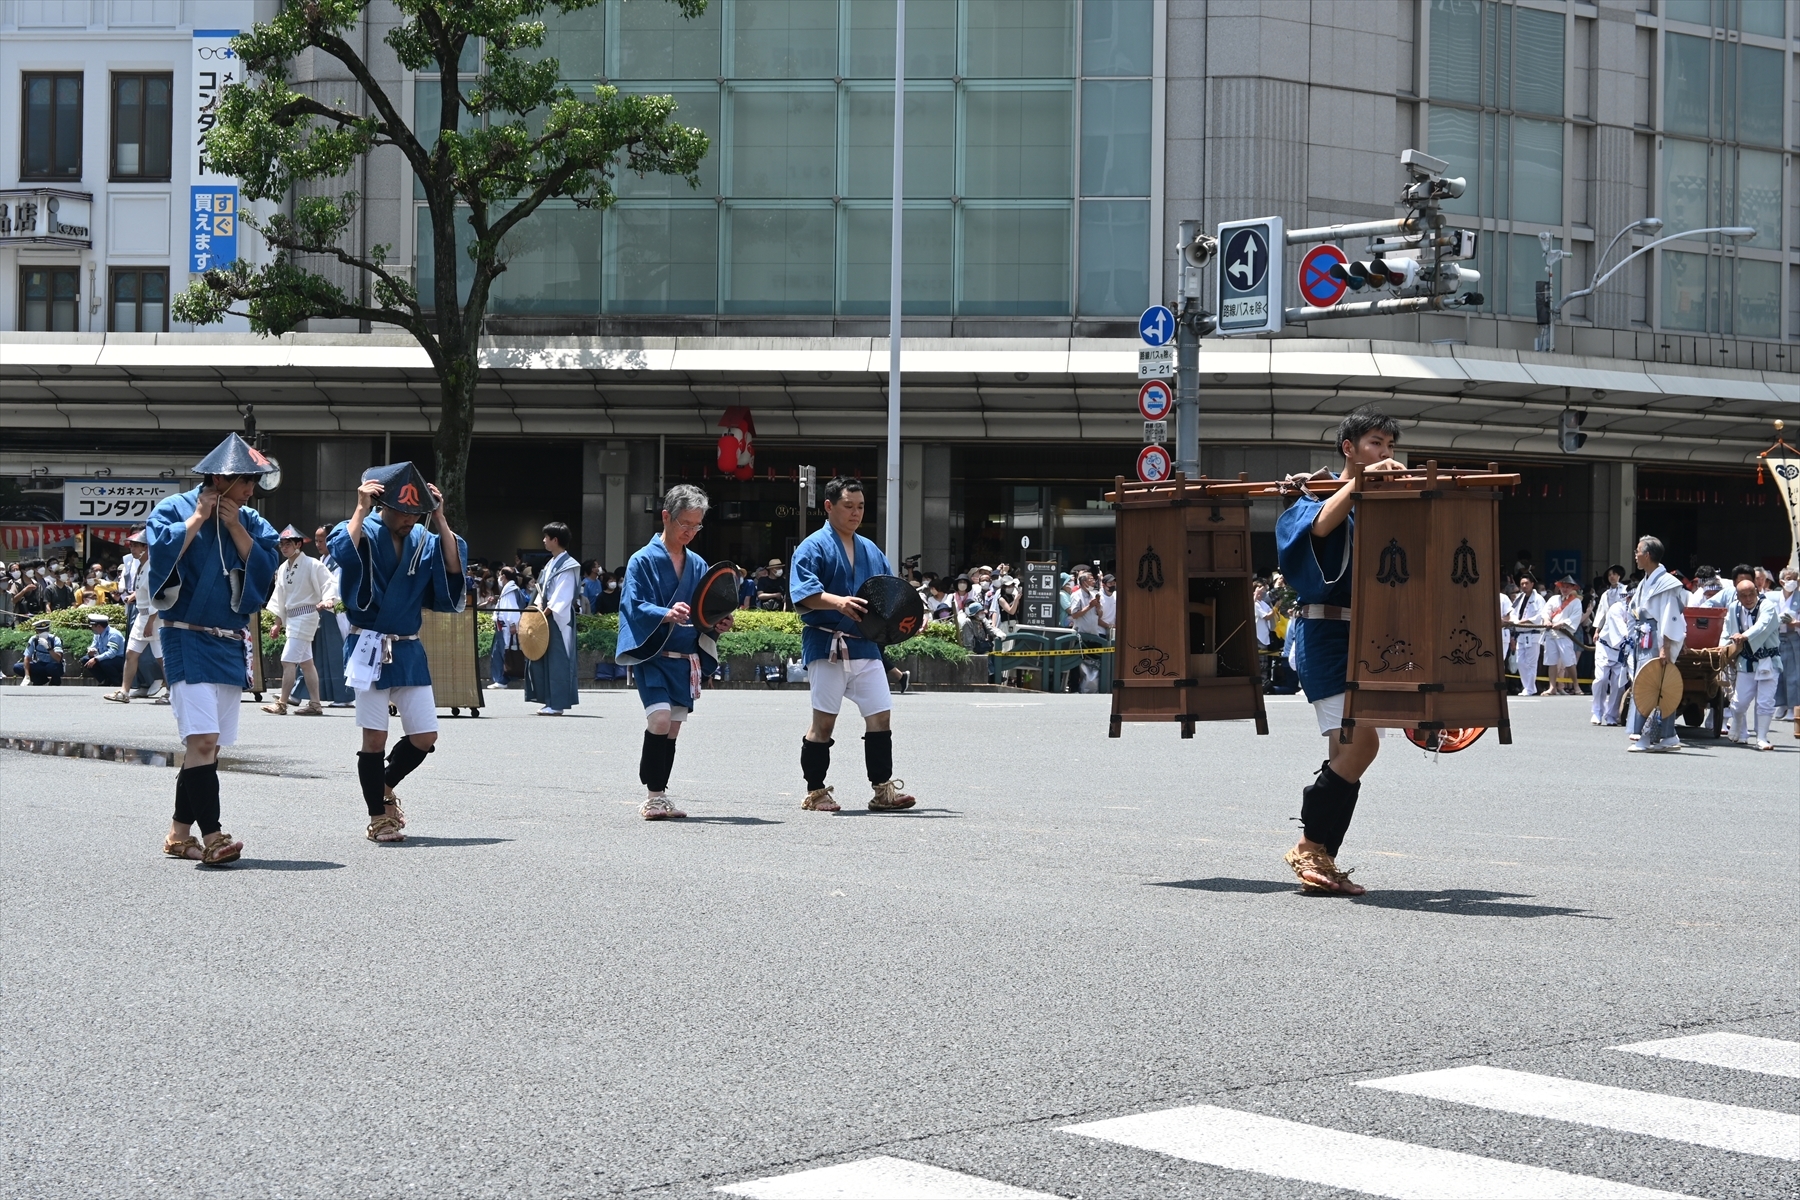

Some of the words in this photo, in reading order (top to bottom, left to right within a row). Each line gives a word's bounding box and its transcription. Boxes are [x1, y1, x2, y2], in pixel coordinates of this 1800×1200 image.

[215, 195, 232, 235] すぐ
[194, 193, 213, 271] 買えます
[1223, 301, 1268, 318] 路線バスを除く
[1140, 350, 1173, 360] 路線バスを除く
[108, 487, 166, 496] メガネスーパー
[1550, 558, 1577, 575] 入口
